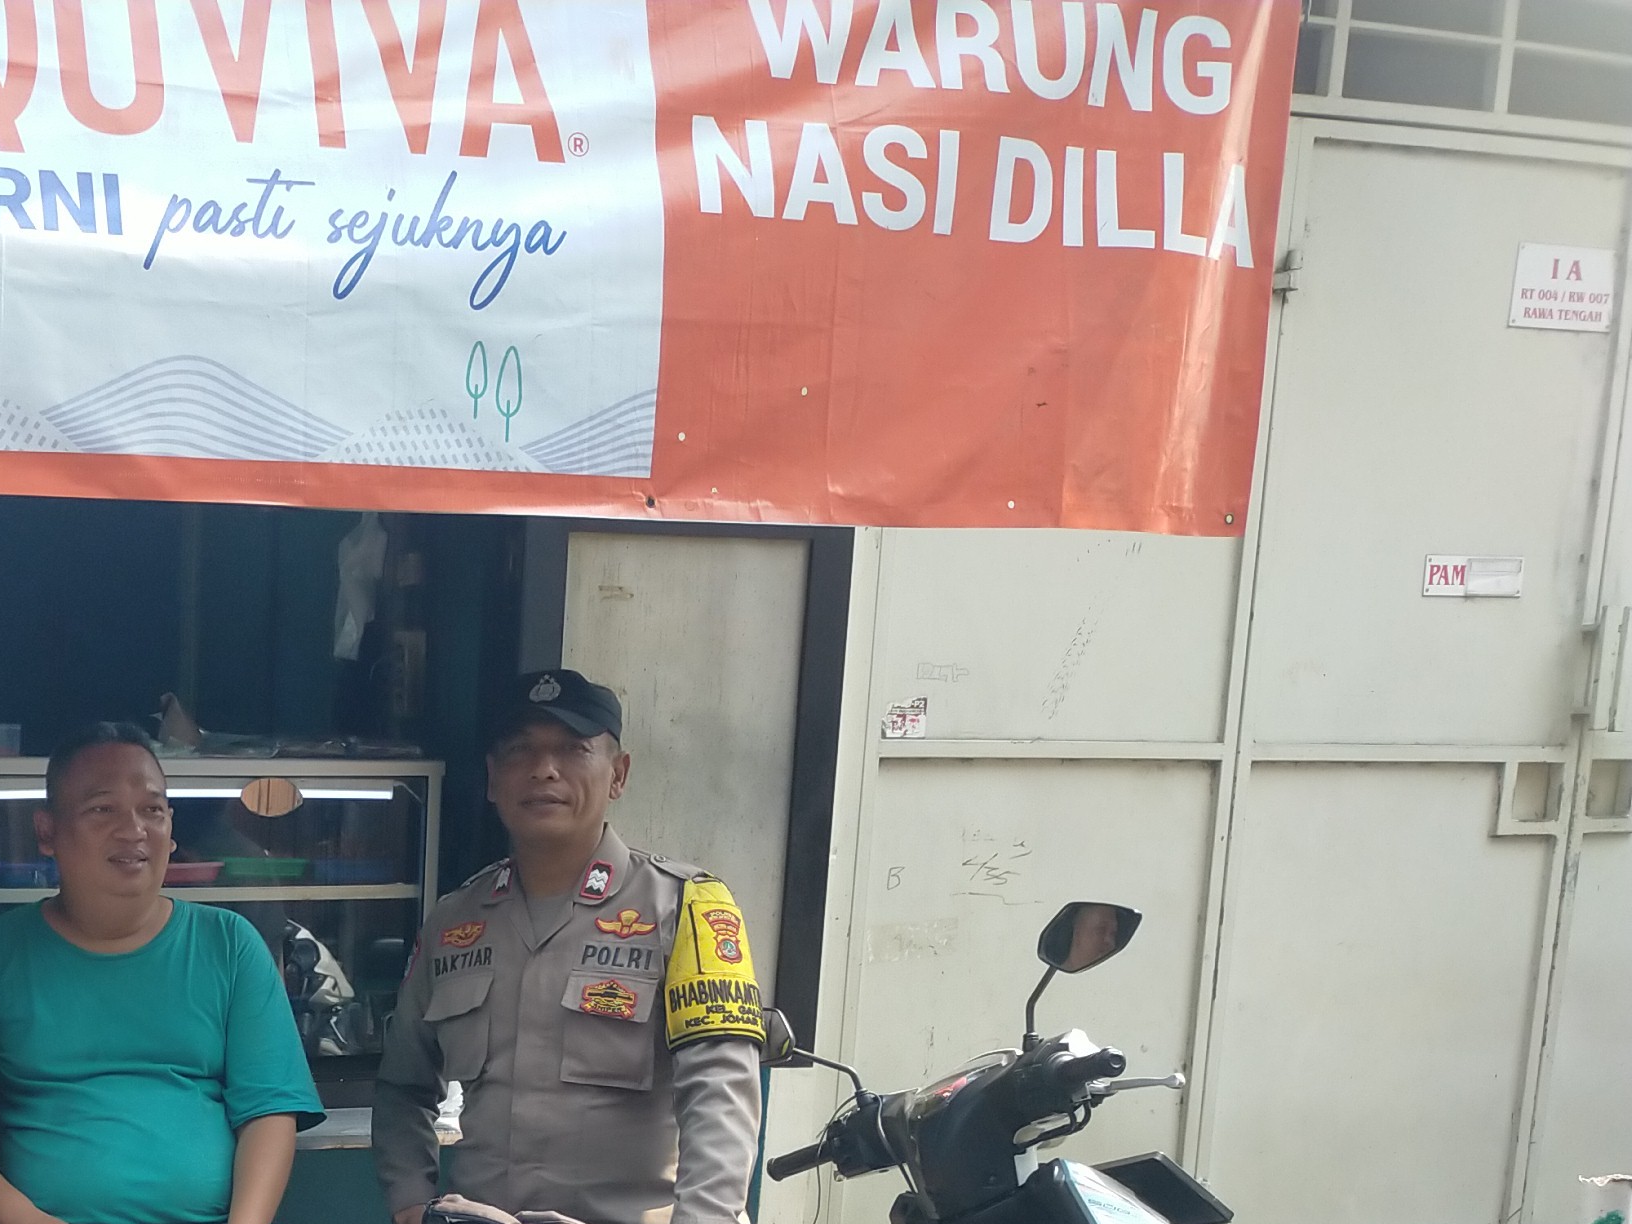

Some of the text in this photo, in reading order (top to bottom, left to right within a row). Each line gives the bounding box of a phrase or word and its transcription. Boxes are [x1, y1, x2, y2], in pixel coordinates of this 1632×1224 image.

[748, 0, 1233, 115] WARUNG
[690, 115, 1255, 269] NASI DILLA
[142, 168, 315, 271] pasti
[326, 170, 568, 311] sejuknya
[1520, 288, 1535, 300] RT
[1523, 307, 1603, 322] RAWA TENGAH
[1428, 565, 1466, 586] PAM
[434, 947, 492, 977] BAKTIAR
[581, 944, 654, 971] POLRI
